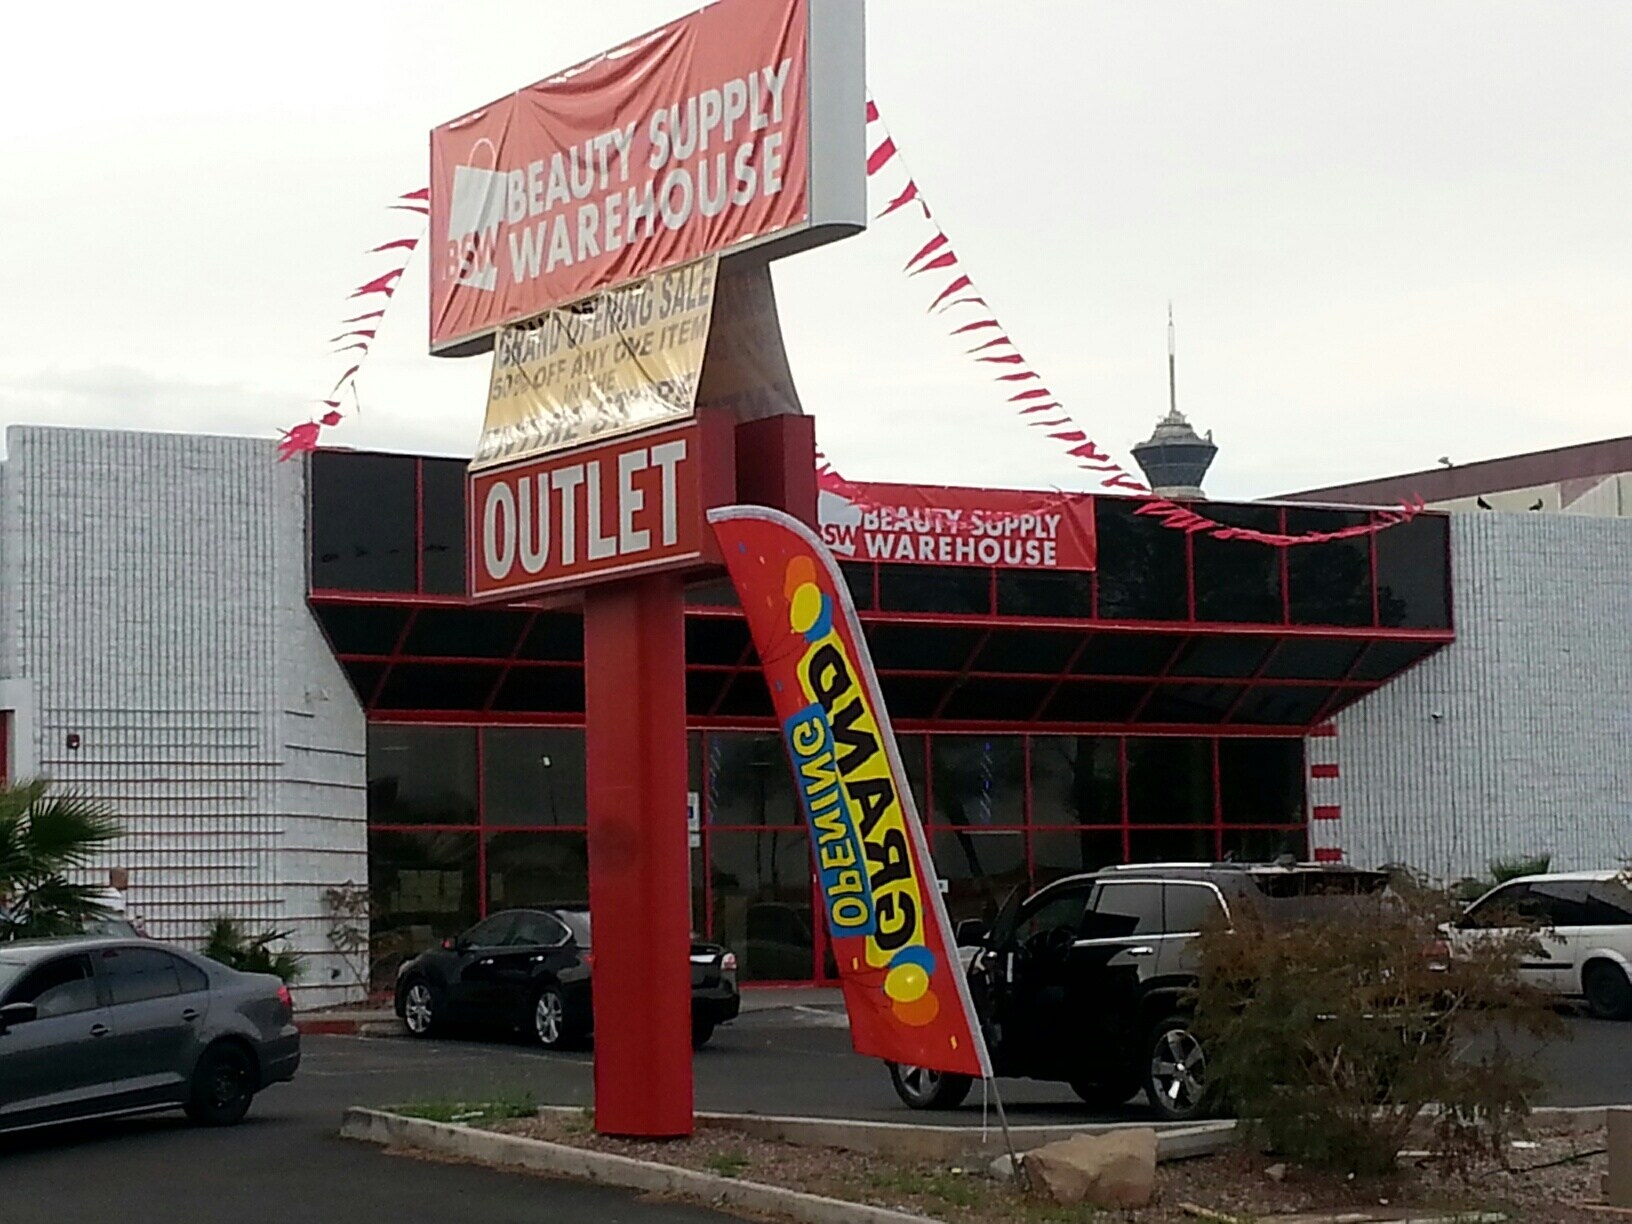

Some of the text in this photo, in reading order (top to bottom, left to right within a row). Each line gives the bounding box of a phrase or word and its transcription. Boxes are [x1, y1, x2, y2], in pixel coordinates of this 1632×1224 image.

[507, 57, 792, 224] BEAUTY SUPPLY
[509, 131, 783, 284] WAREHOUSE
[659, 258, 715, 320] SALE
[533, 356, 567, 386] OFF
[570, 343, 611, 379] ANY
[613, 330, 652, 361] ONE
[659, 312, 709, 350] ITEM
[483, 438, 687, 580] OUTLET
[863, 506, 1061, 538] BEAUTY SUPPLY
[865, 532, 1057, 566] WAREHOUSE
